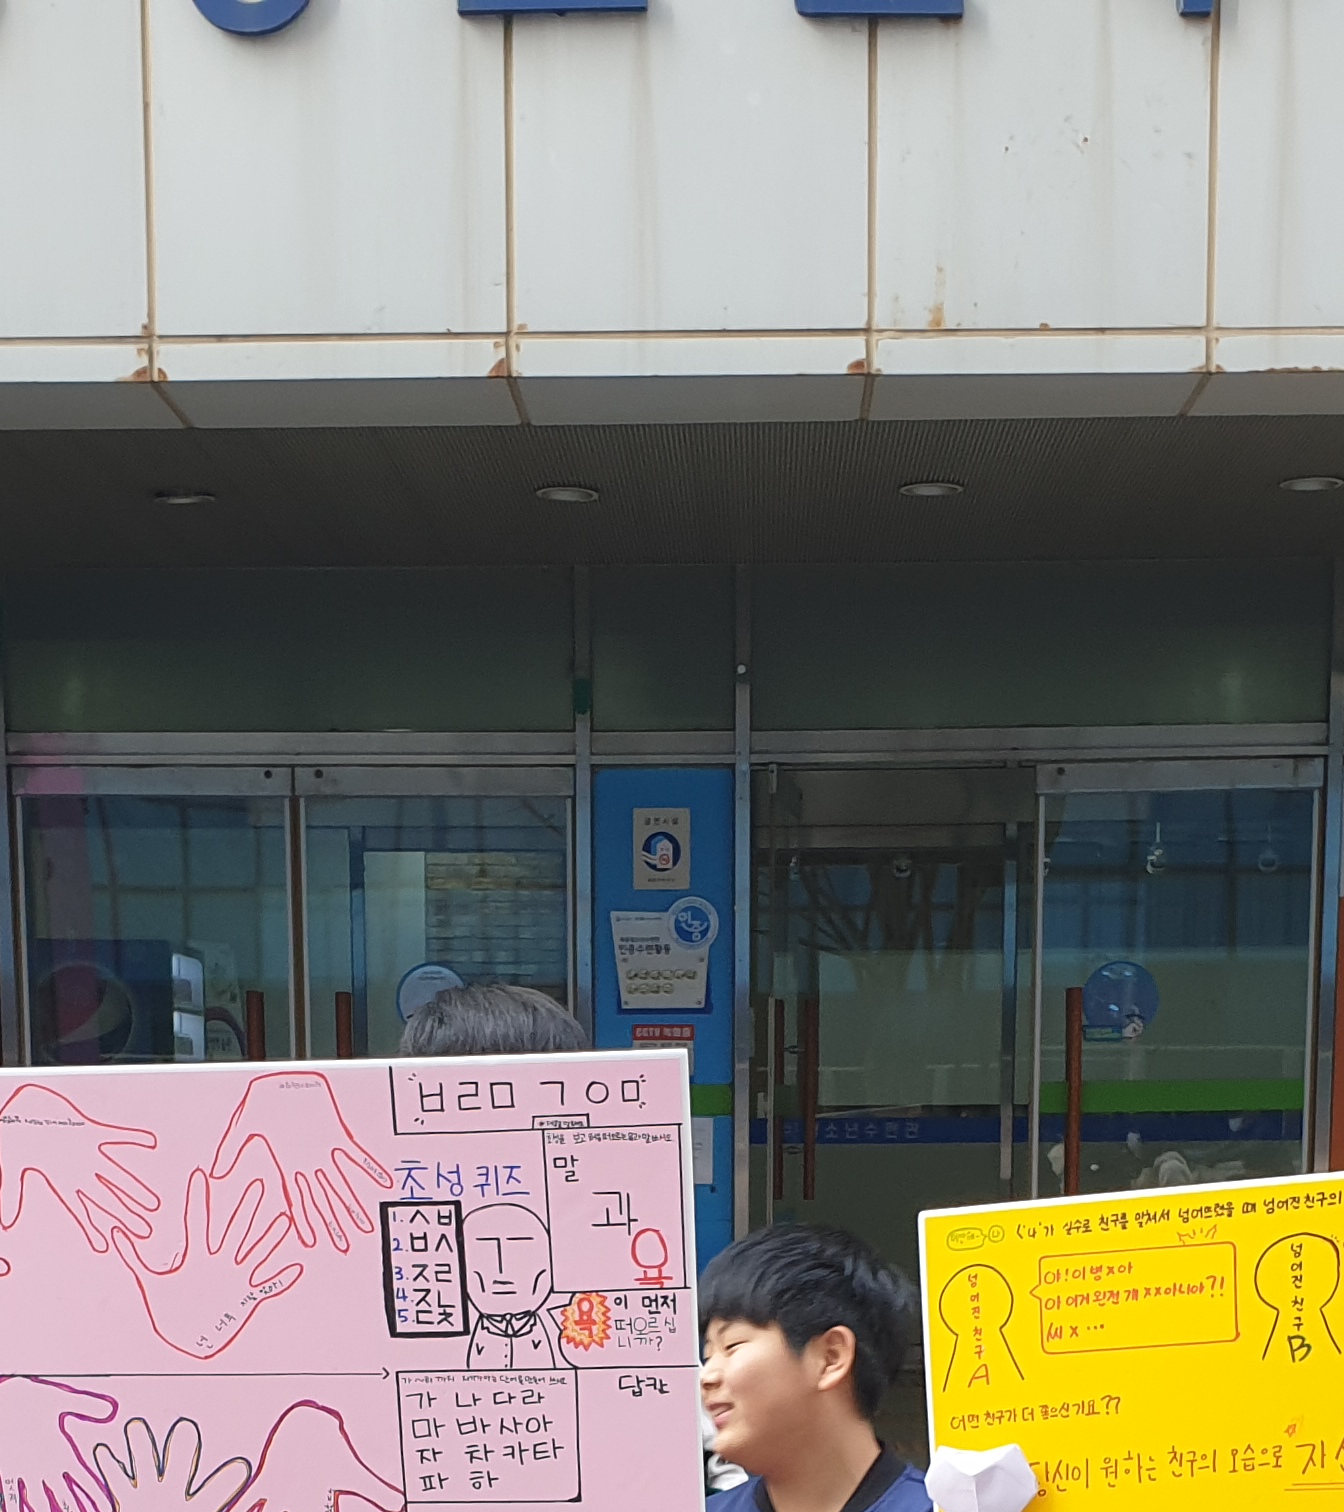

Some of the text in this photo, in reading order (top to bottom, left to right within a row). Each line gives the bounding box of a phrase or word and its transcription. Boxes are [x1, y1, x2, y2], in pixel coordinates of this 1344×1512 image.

[815, 1120, 920, 1140] 소년수련관
[393, 1159, 464, 1202] 초성
[472, 1164, 531, 1198] 퀴즈
[552, 1154, 580, 1183] 말
[591, 1191, 640, 1238] 과
[629, 1226, 675, 1289] 욕
[641, 1292, 677, 1316] 먼저
[1286, 1334, 1313, 1364] B
[1099, 1449, 1157, 1489] 원하는
[1167, 1444, 1217, 1478] 친구의
[1228, 1443, 1283, 1474] 모습으로
